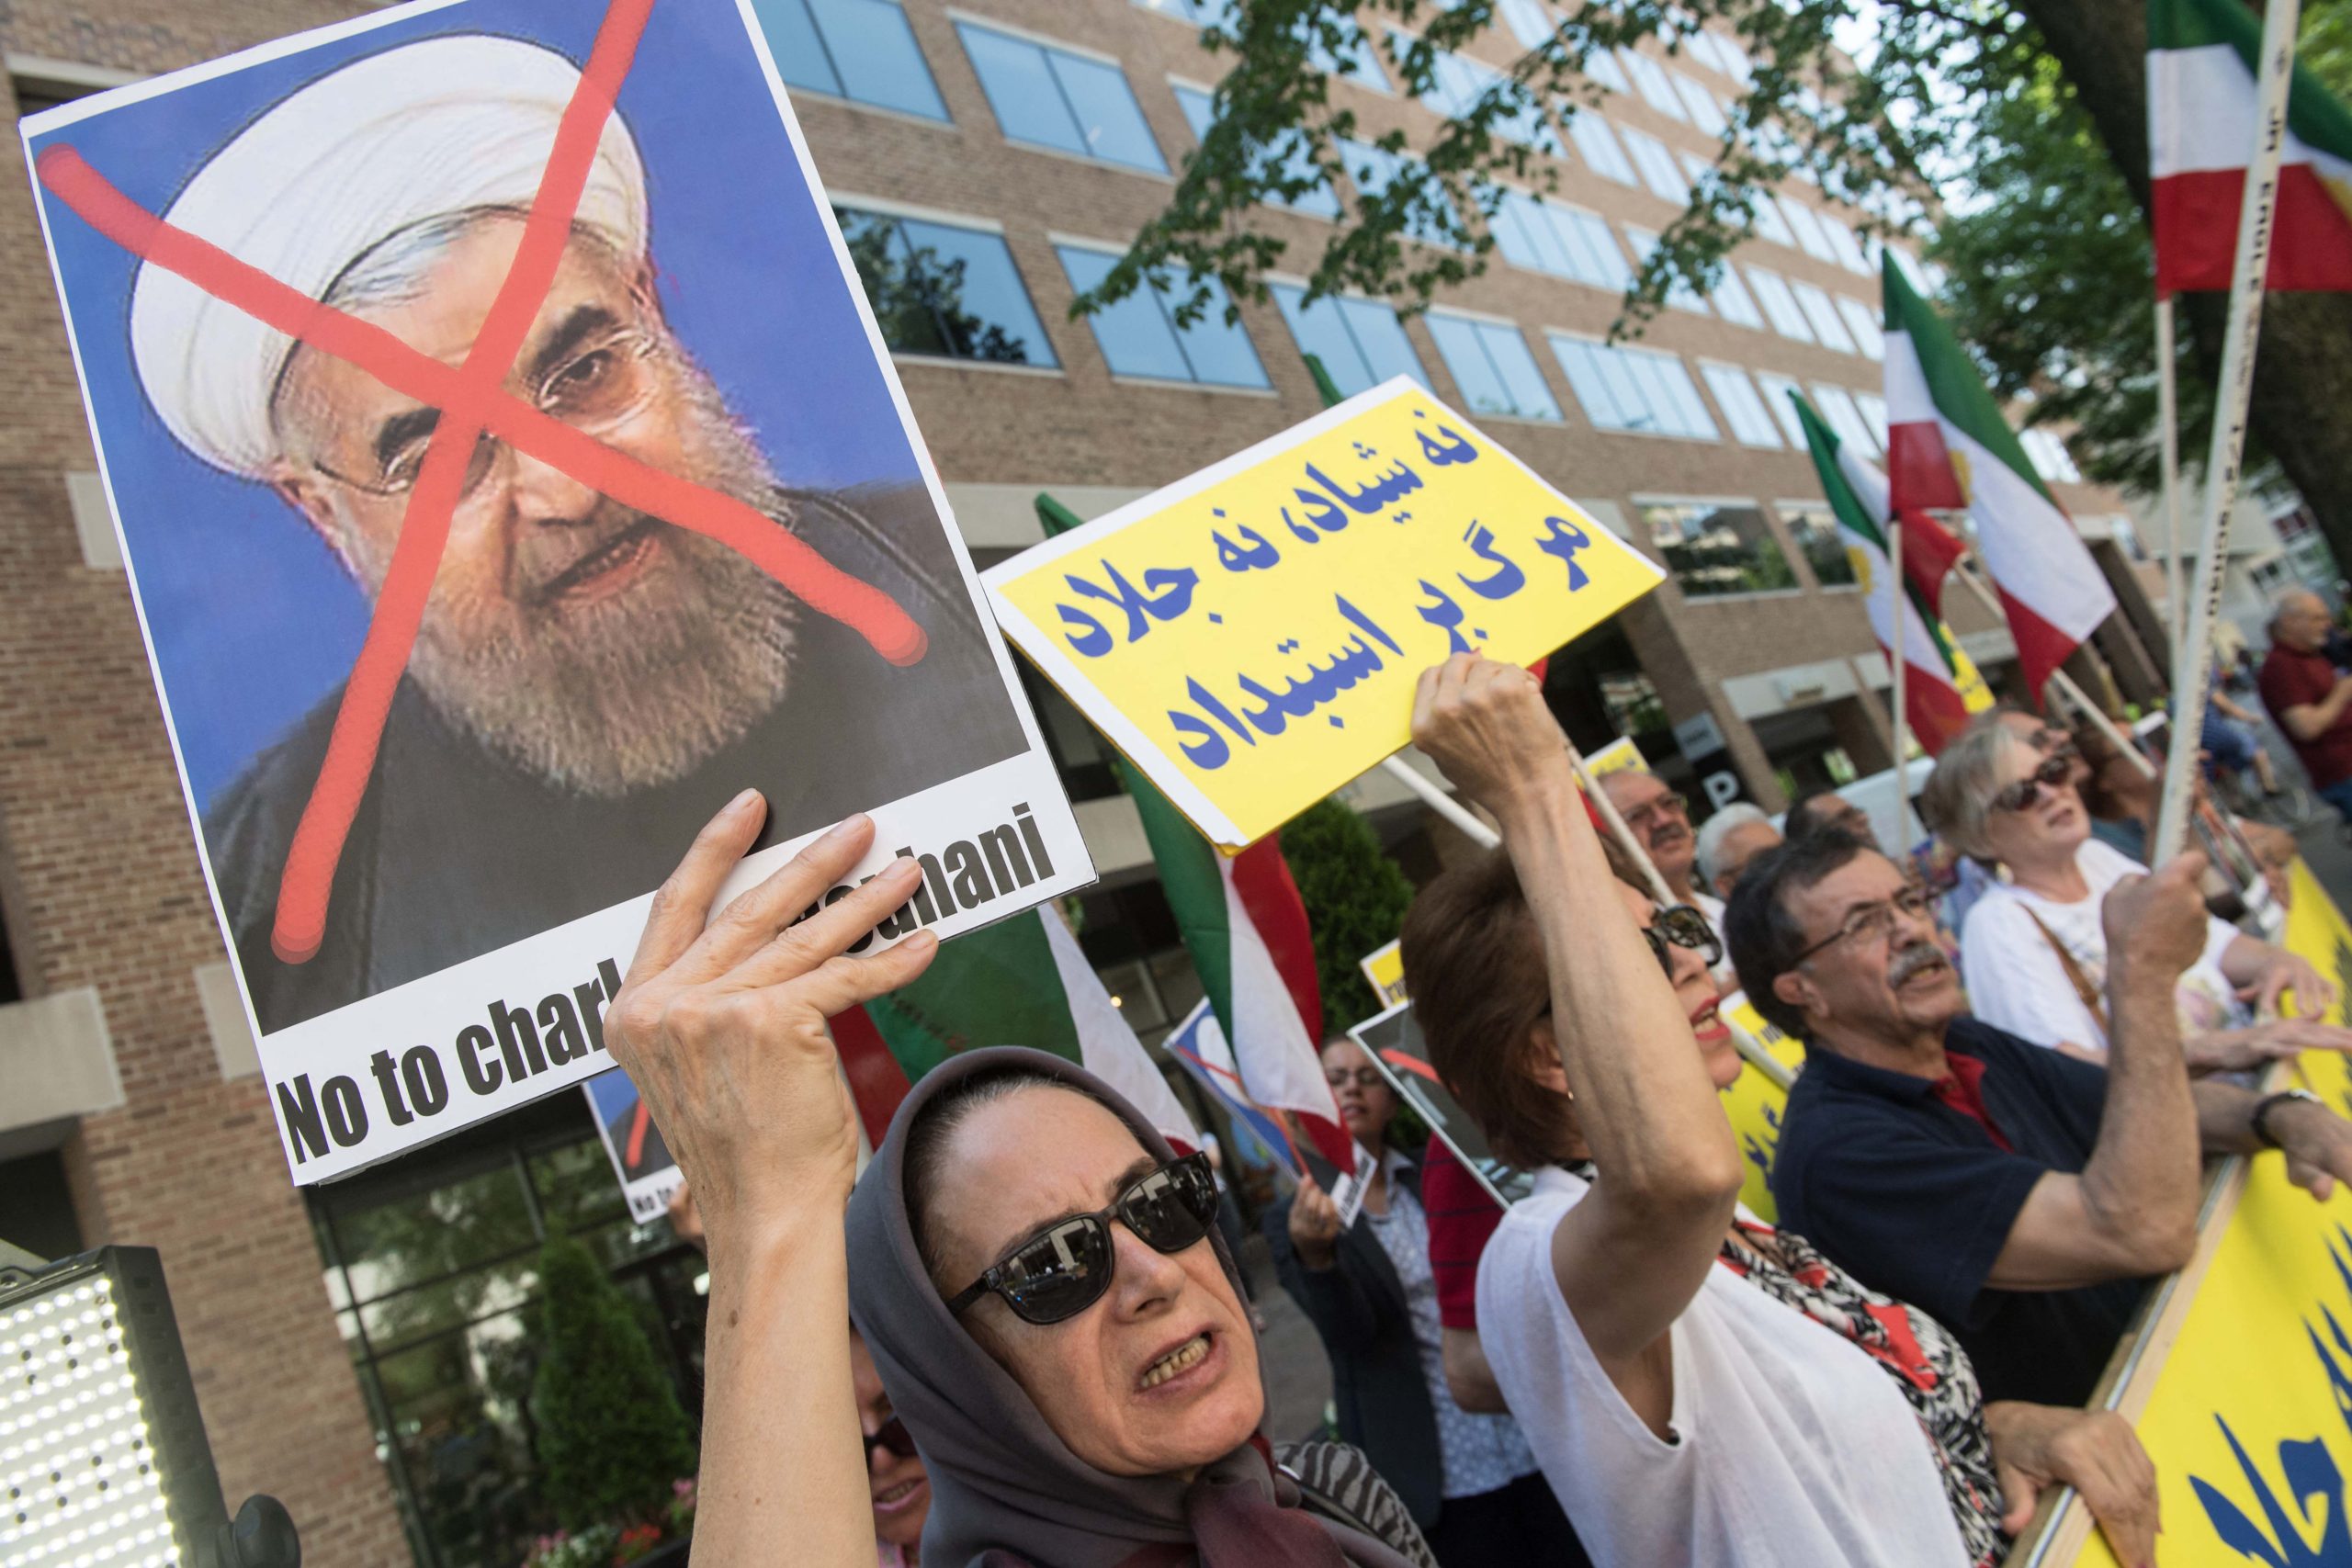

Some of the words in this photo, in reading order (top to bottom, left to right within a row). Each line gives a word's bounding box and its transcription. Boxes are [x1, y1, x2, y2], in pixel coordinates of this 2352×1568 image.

[2247, 182, 2274, 292] EAGLE
[1413, 409, 1479, 466] نه
[1212, 508, 1281, 573] نه
[1455, 516, 1591, 600] مرگ
[1055, 558, 1223, 658] جلاد
[1167, 592, 1404, 770] استبداد
[1702, 770, 1739, 811] P
[276, 1072, 368, 1165] No
[370, 1049, 448, 1126] to
[456, 956, 623, 1096] charl
